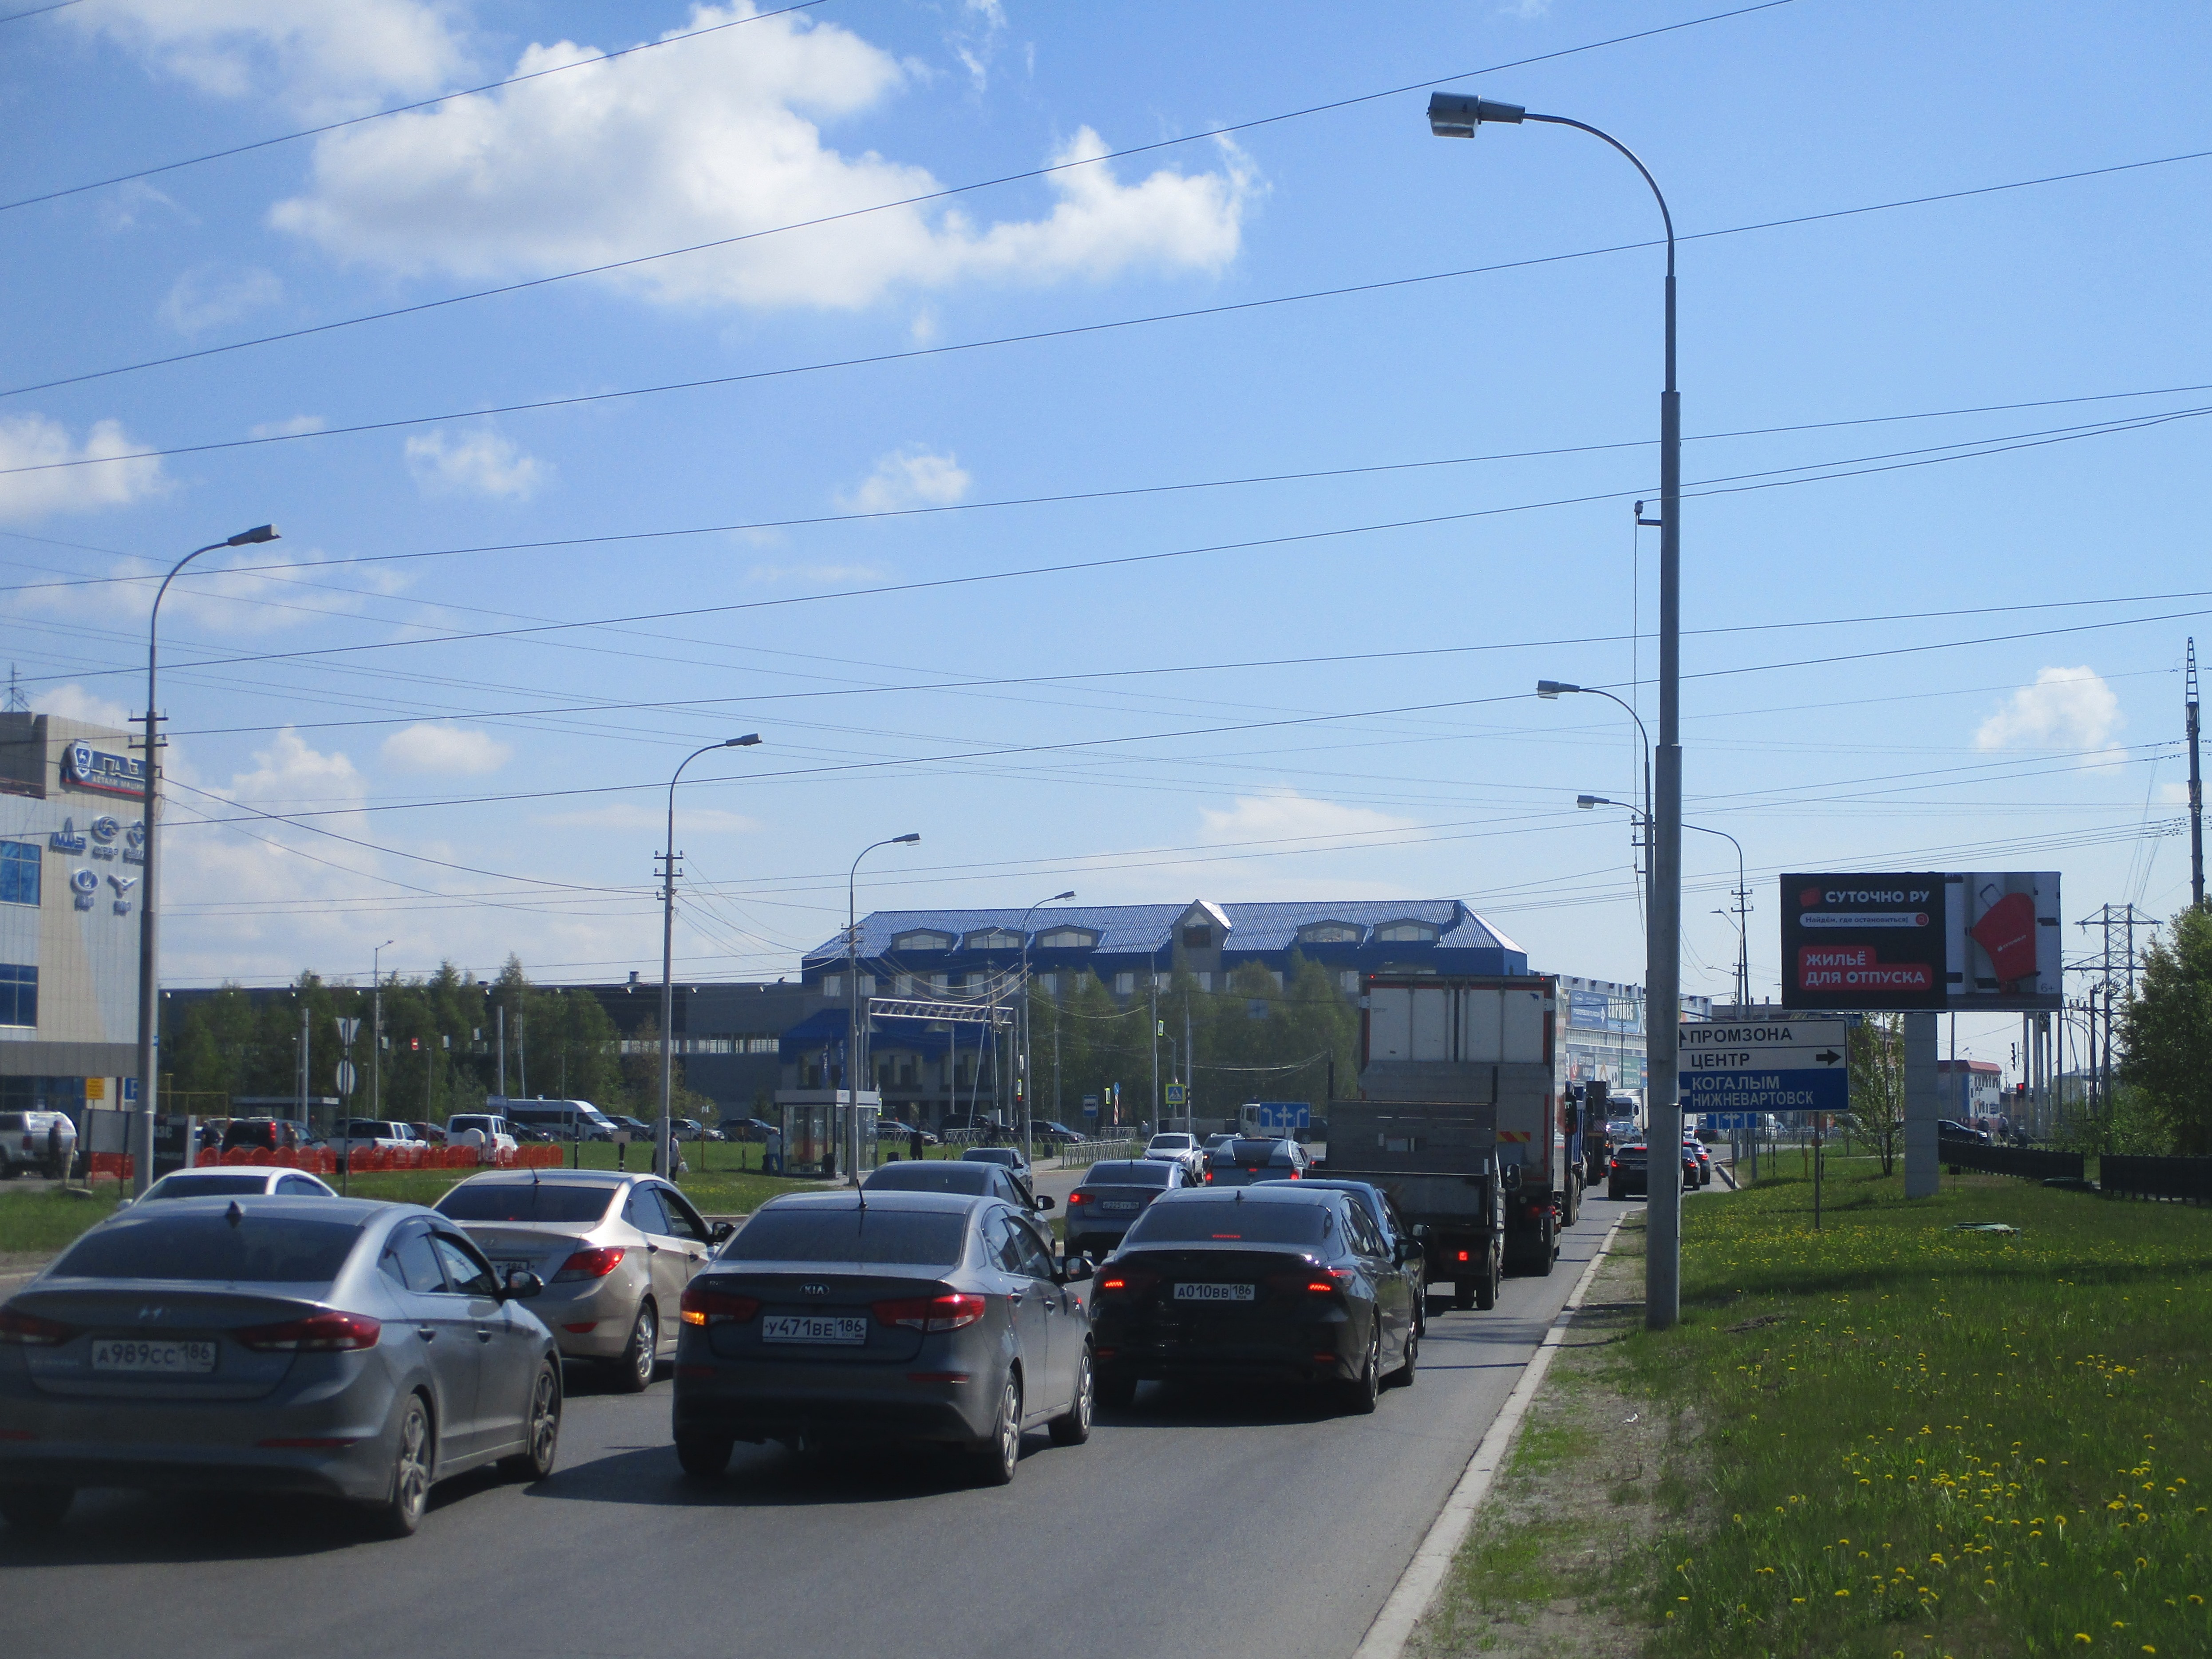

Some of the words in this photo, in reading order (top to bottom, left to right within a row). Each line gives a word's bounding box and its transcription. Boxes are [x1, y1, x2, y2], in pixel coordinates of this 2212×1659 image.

[1806, 951, 1866, 966] ЖИЛЬЁ
[1805, 972, 1841, 986] ДЛЯ
[1846, 972, 1925, 983] ОТПУСКА
[2041, 983, 2054, 992] 6+
[1690, 1027, 1792, 1043] ПРОМЗОНА
[1691, 1053, 1750, 1070] ЦЕНТР
[1692, 1076, 1780, 1090] КОГАЛЫМ
[1692, 1090, 1813, 1107] НИЖНЕВАРТОВСК
[804, 1285, 825, 1294] KIA
